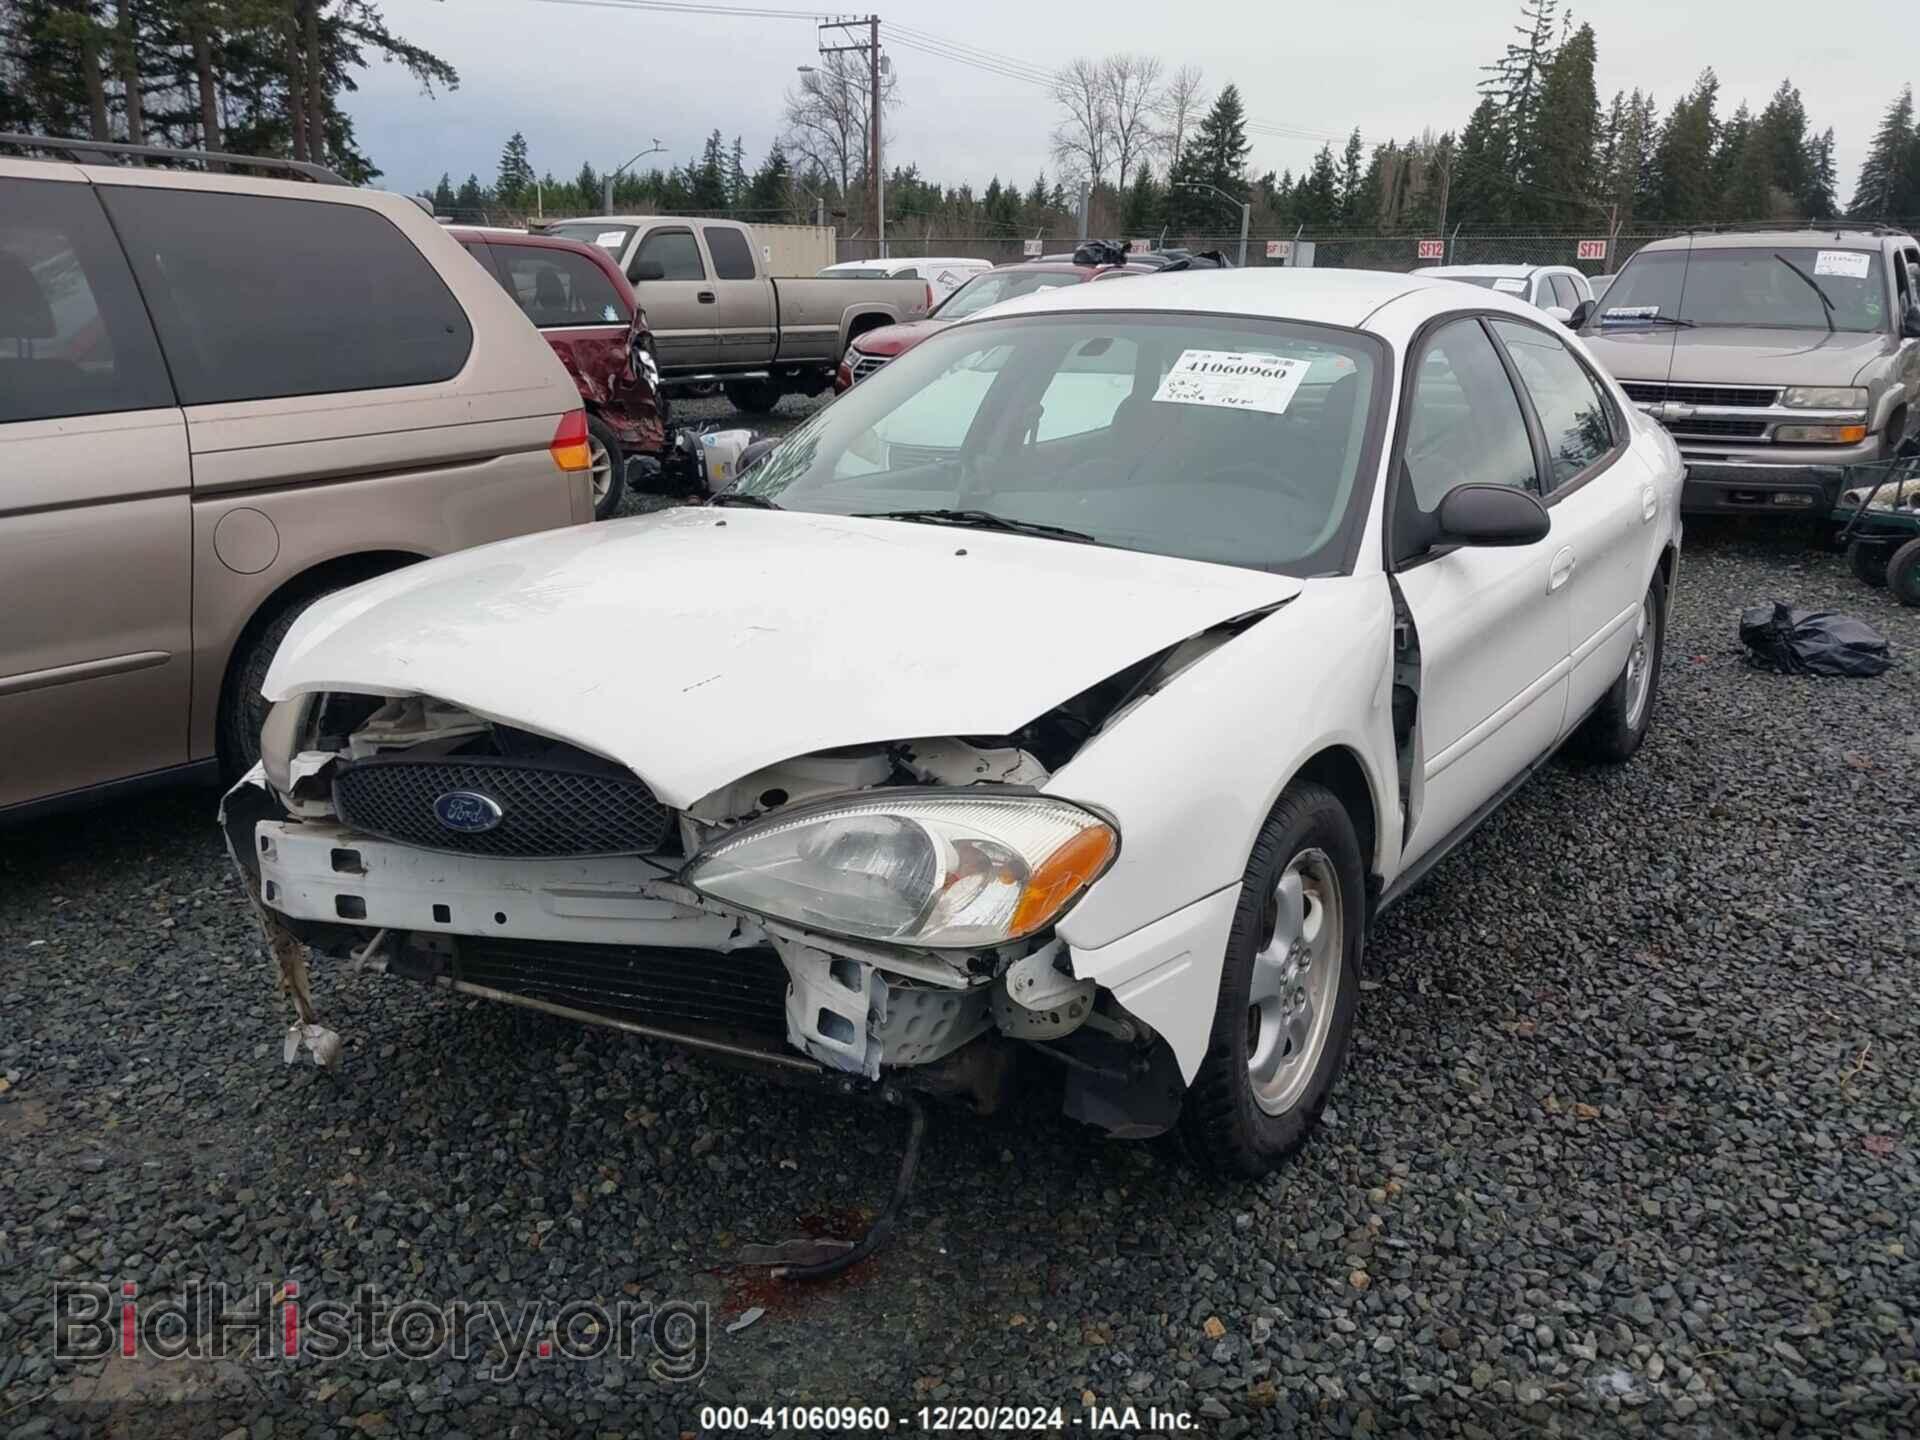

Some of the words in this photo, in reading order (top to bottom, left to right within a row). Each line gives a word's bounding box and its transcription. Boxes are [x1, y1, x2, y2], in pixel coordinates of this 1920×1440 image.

[1420, 242, 1442, 257] SF12
[1580, 242, 1604, 257] SF11
[1185, 361, 1287, 379] 41060960
[447, 798, 483, 823] Ford
